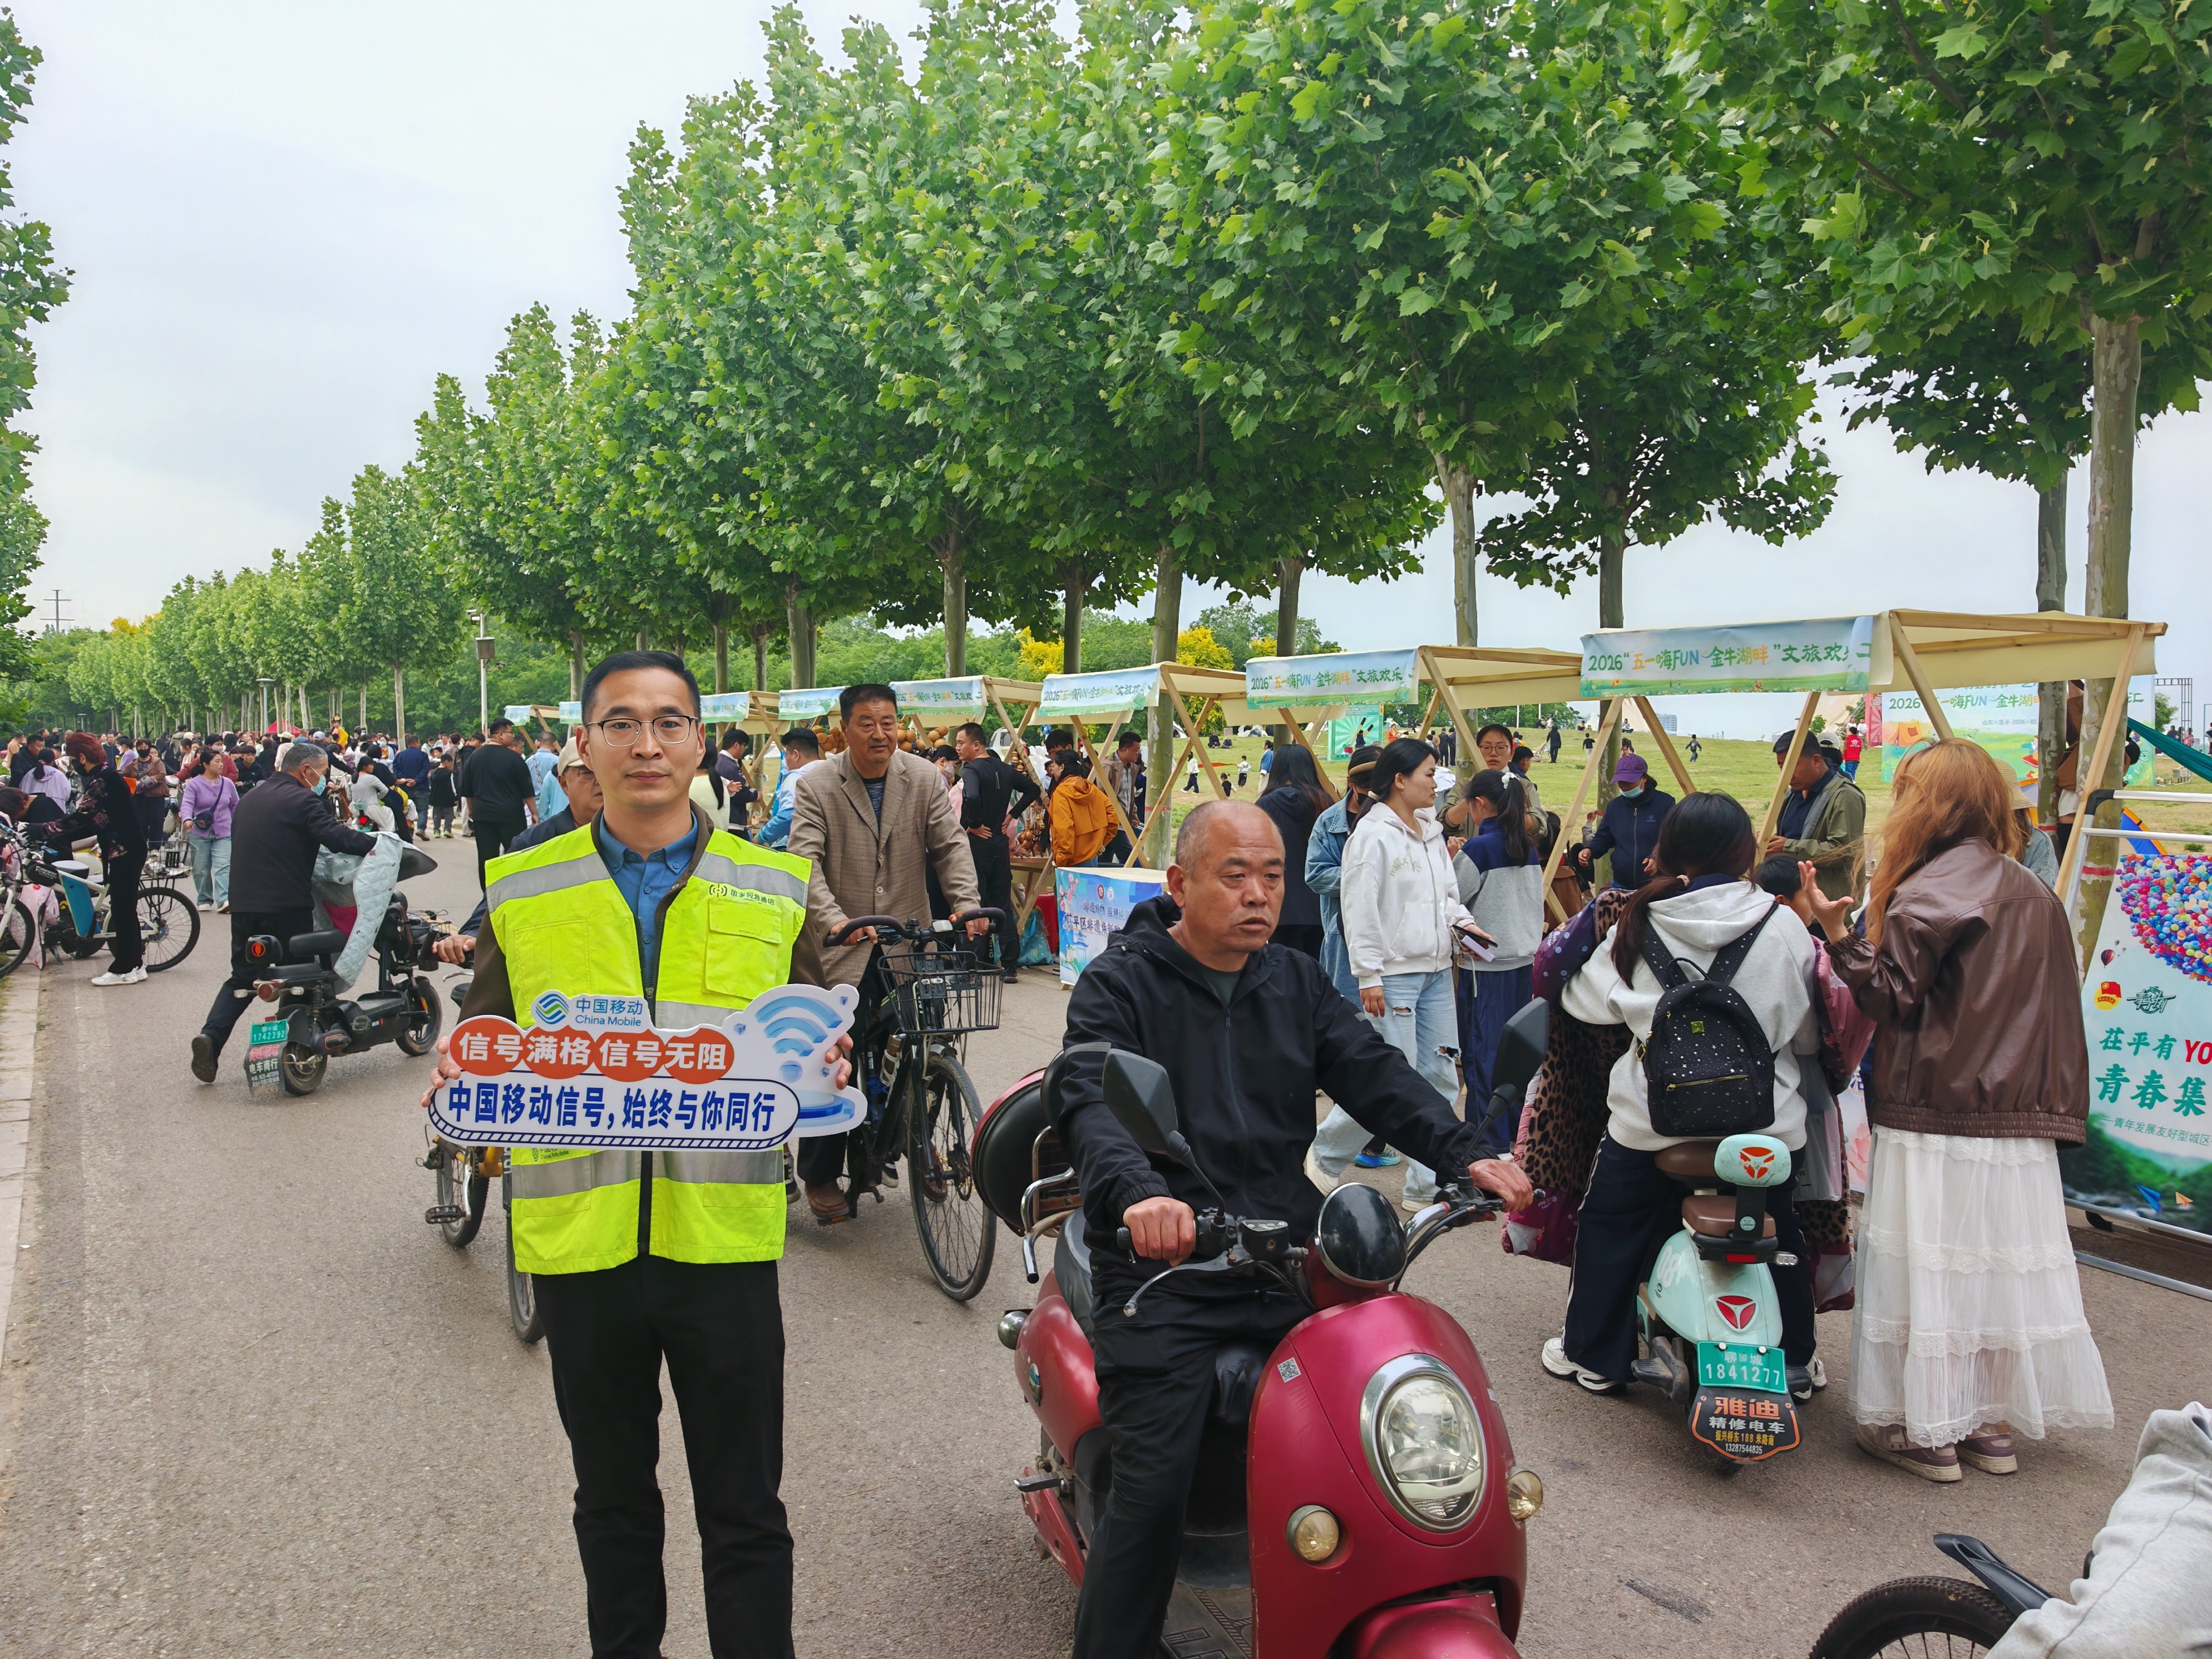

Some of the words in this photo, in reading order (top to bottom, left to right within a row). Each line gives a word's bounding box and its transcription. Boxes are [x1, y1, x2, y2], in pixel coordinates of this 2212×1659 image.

[576, 997, 643, 1015] 中国移动
[575, 1014, 605, 1025] China
[608, 1016, 642, 1027] Mobile
[253, 1030, 285, 1042] 1742392
[2099, 1027, 2177, 1061] 茌平有
[459, 1031, 591, 1067] 信号满格
[599, 1037, 727, 1071] 信号无阻
[249, 1058, 279, 1074] 电车商行
[2095, 1063, 2207, 1117] 青春集
[1705, 1363, 1781, 1386] 1841277
[1714, 1397, 1781, 1420] 雅迪
[1709, 1416, 1785, 1434] 精修电车
[1725, 1443, 1763, 1454] 13287544835
